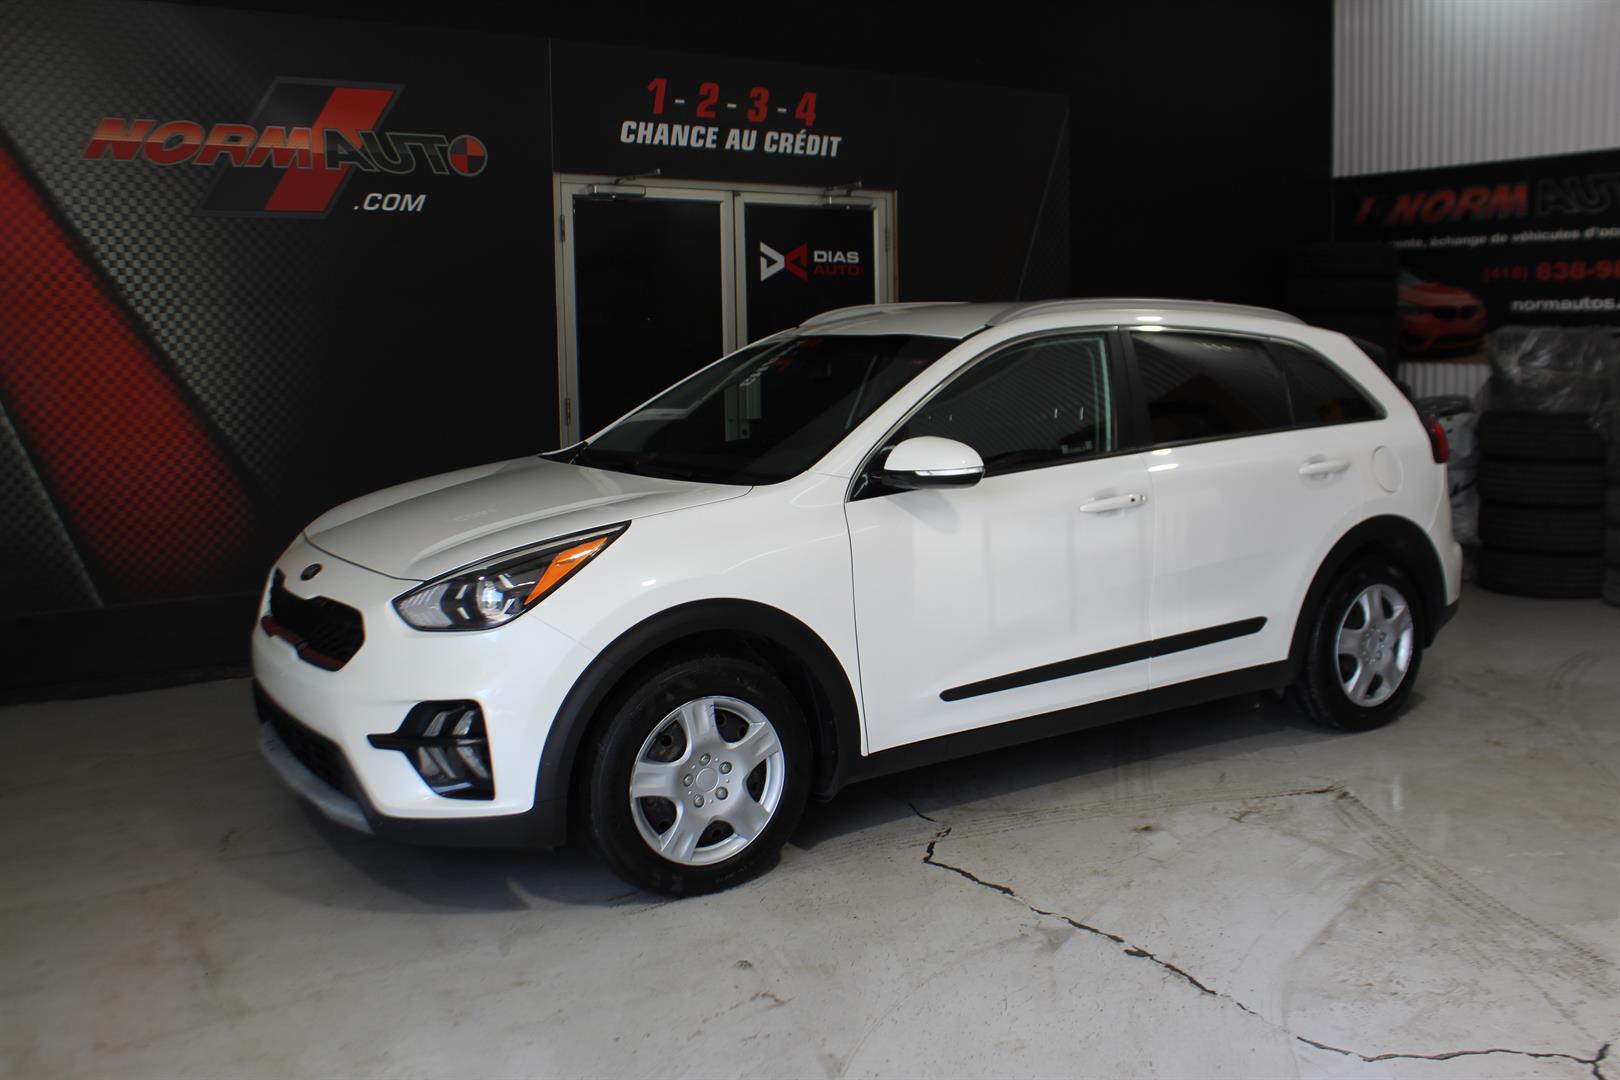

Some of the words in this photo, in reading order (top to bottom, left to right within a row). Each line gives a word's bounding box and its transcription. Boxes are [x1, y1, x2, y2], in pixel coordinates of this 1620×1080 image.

[620, 120, 719, 149] CHANCE
[724, 128, 757, 151] AU
[763, 129, 842, 158] CRÉDIT
[1387, 183, 1529, 224] NORM
[1386, 237, 1427, 249] ente,
[1489, 232, 1509, 244] de
[1511, 228, 1581, 242] véhicules
[813, 250, 860, 264] DIAS
[813, 265, 862, 277] AUTO
